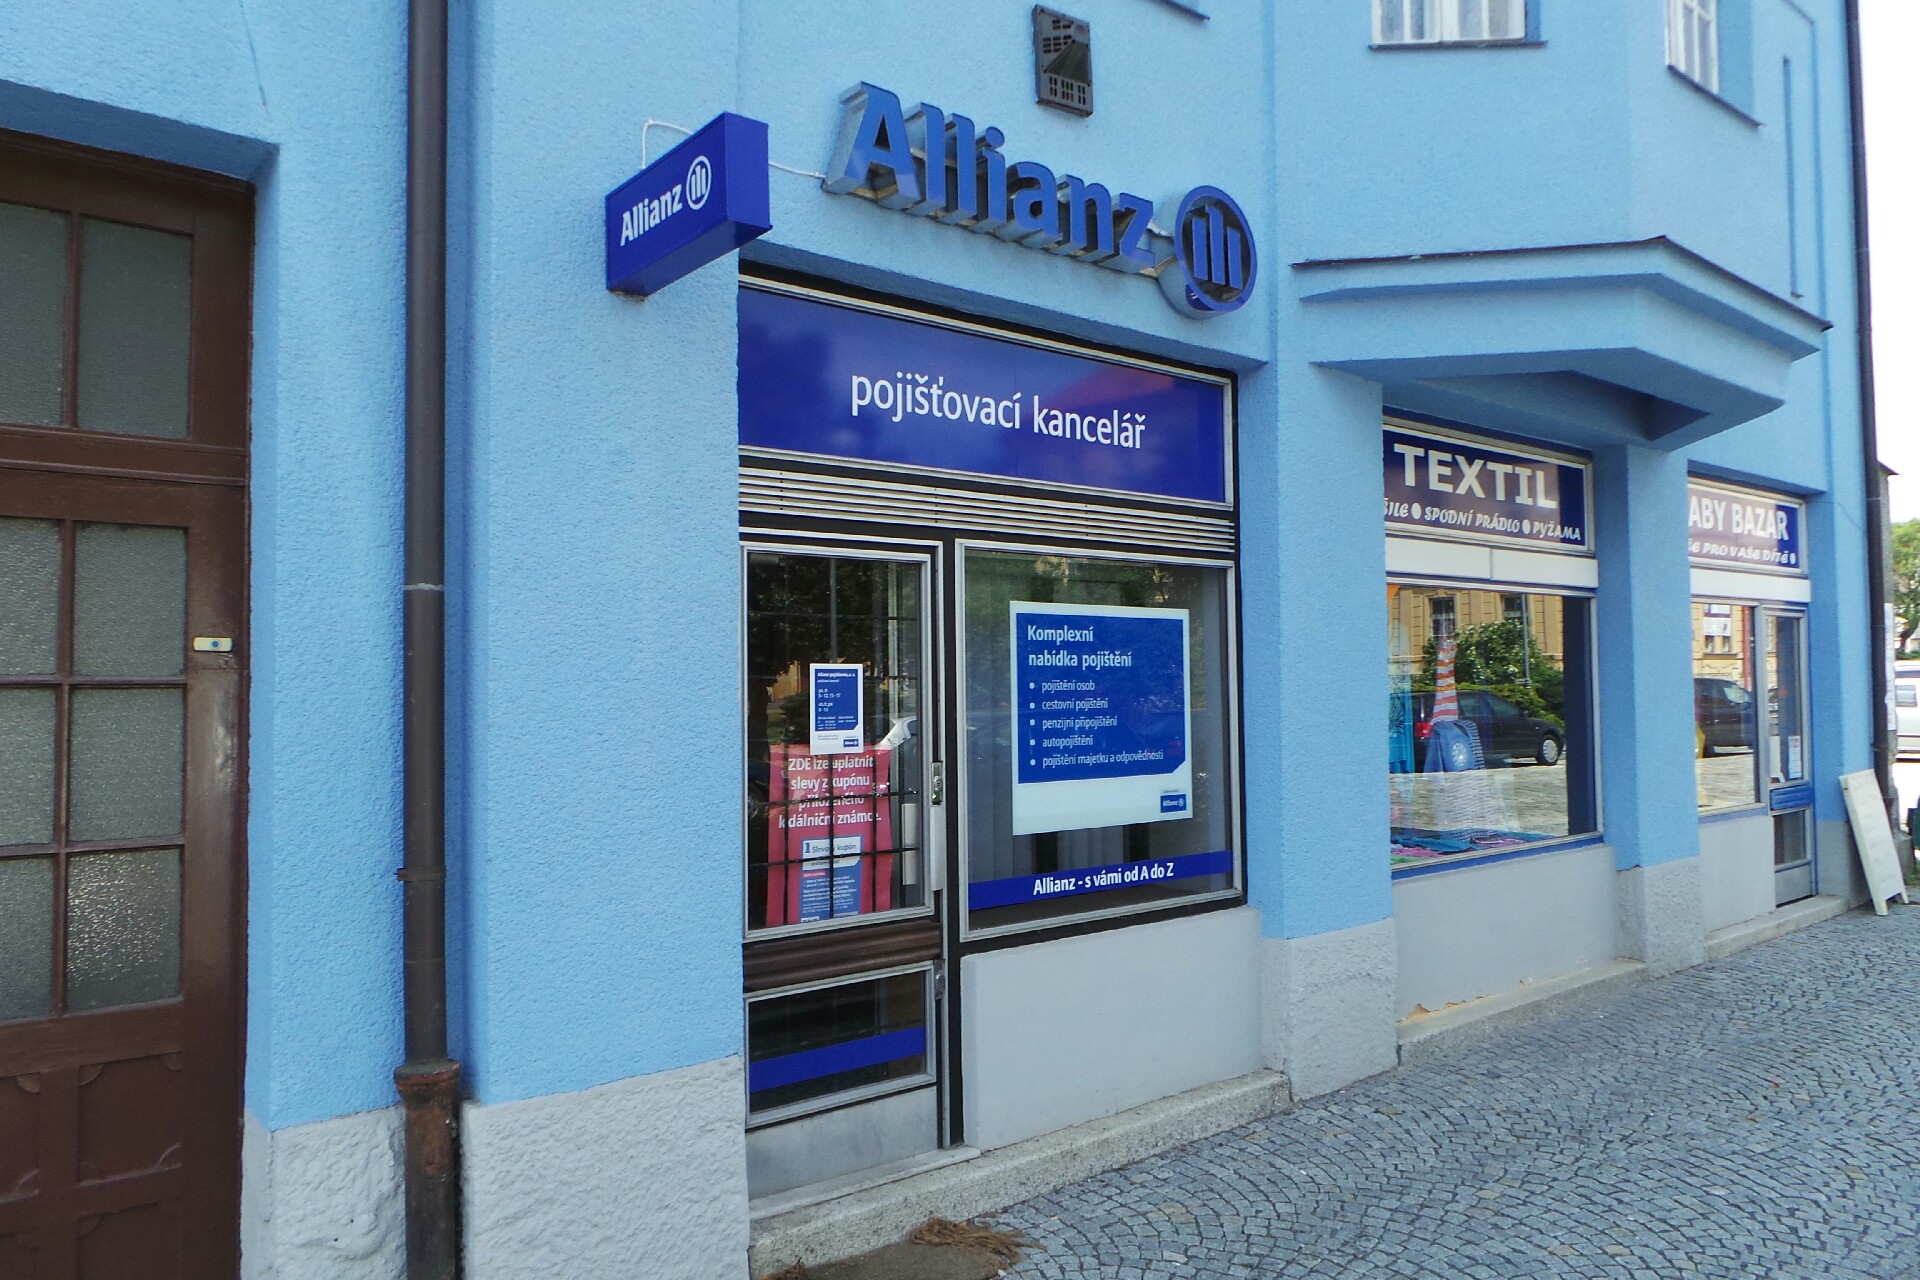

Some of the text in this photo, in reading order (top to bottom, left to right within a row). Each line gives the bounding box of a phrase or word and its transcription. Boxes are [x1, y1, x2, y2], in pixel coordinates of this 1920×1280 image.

[843, 81, 1155, 268] Allianz
[620, 184, 683, 247] Allianz
[851, 371, 1146, 449] pojišťovací kancelář
[1393, 443, 1558, 509] TEXTIL
[1424, 505, 1473, 527] SPODNÍ
[1475, 512, 1520, 533] PRÁDLO
[1532, 520, 1582, 541] PYŽAMA
[1688, 495, 1789, 541] ABY BAZAR
[1702, 542, 1728, 556] PRO
[1729, 545, 1761, 560] VAŠE
[1027, 625, 1094, 646] Komplexní
[1028, 650, 1132, 671] nabídka pojištění
[1041, 679, 1096, 694] pojištění osob
[1041, 697, 1109, 712] cestovní pojištění
[1042, 716, 1074, 731] penzijní
[1042, 735, 1094, 749] autopojištění
[788, 758, 812, 771] ZDE
[814, 757, 829, 770] lze
[1042, 749, 1164, 769] pojištění majetku a odpovědnosti
[791, 776, 820, 792] slevy
[804, 842, 811, 854] 1
[1033, 876, 1076, 896] Allianz
[1085, 876, 1091, 888] s
[1093, 869, 1122, 887] vámi
[1124, 866, 1139, 882] od
[1140, 865, 1149, 880] A
[1150, 863, 1165, 879] do
[1166, 862, 1174, 877] Z
